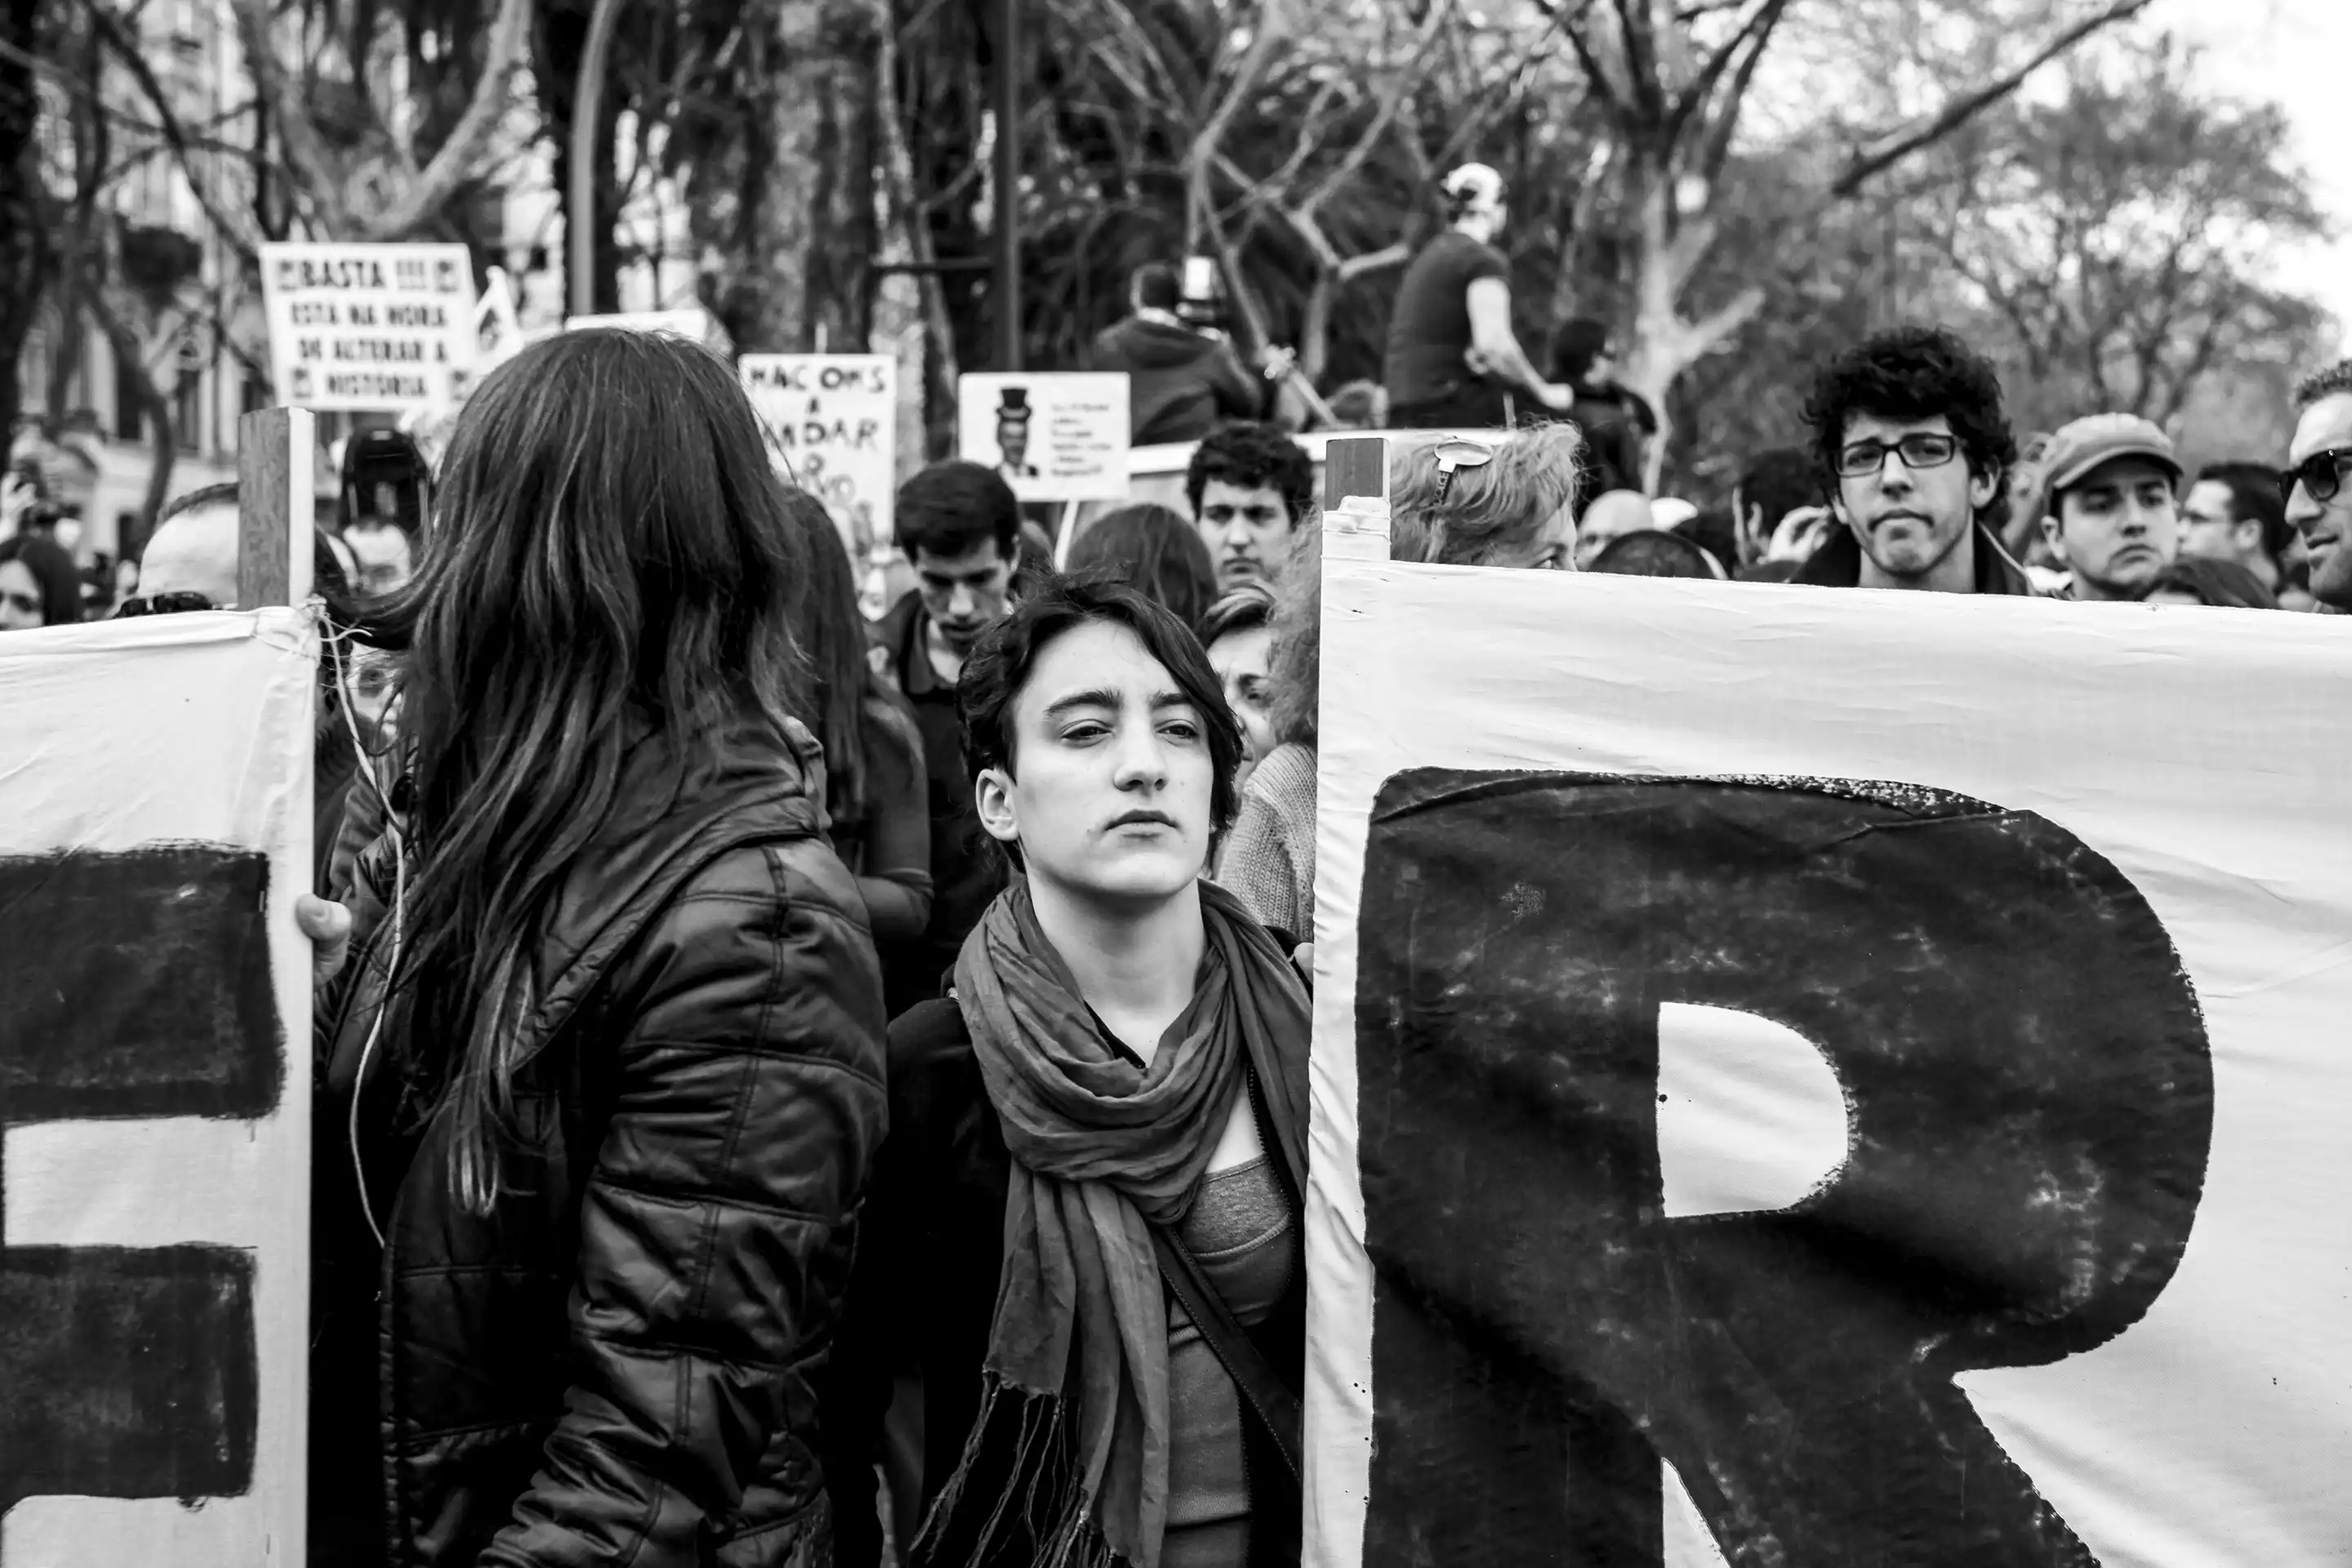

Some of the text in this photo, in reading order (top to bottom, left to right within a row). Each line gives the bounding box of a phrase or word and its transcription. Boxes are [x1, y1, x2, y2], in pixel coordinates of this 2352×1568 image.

[303, 260, 385, 287] BASTA
[349, 303, 376, 325] NA
[386, 304, 448, 327] HORA
[334, 338, 422, 361] ALTERAR
[435, 339, 448, 361] A
[1356, 766, 2214, 1568] R
